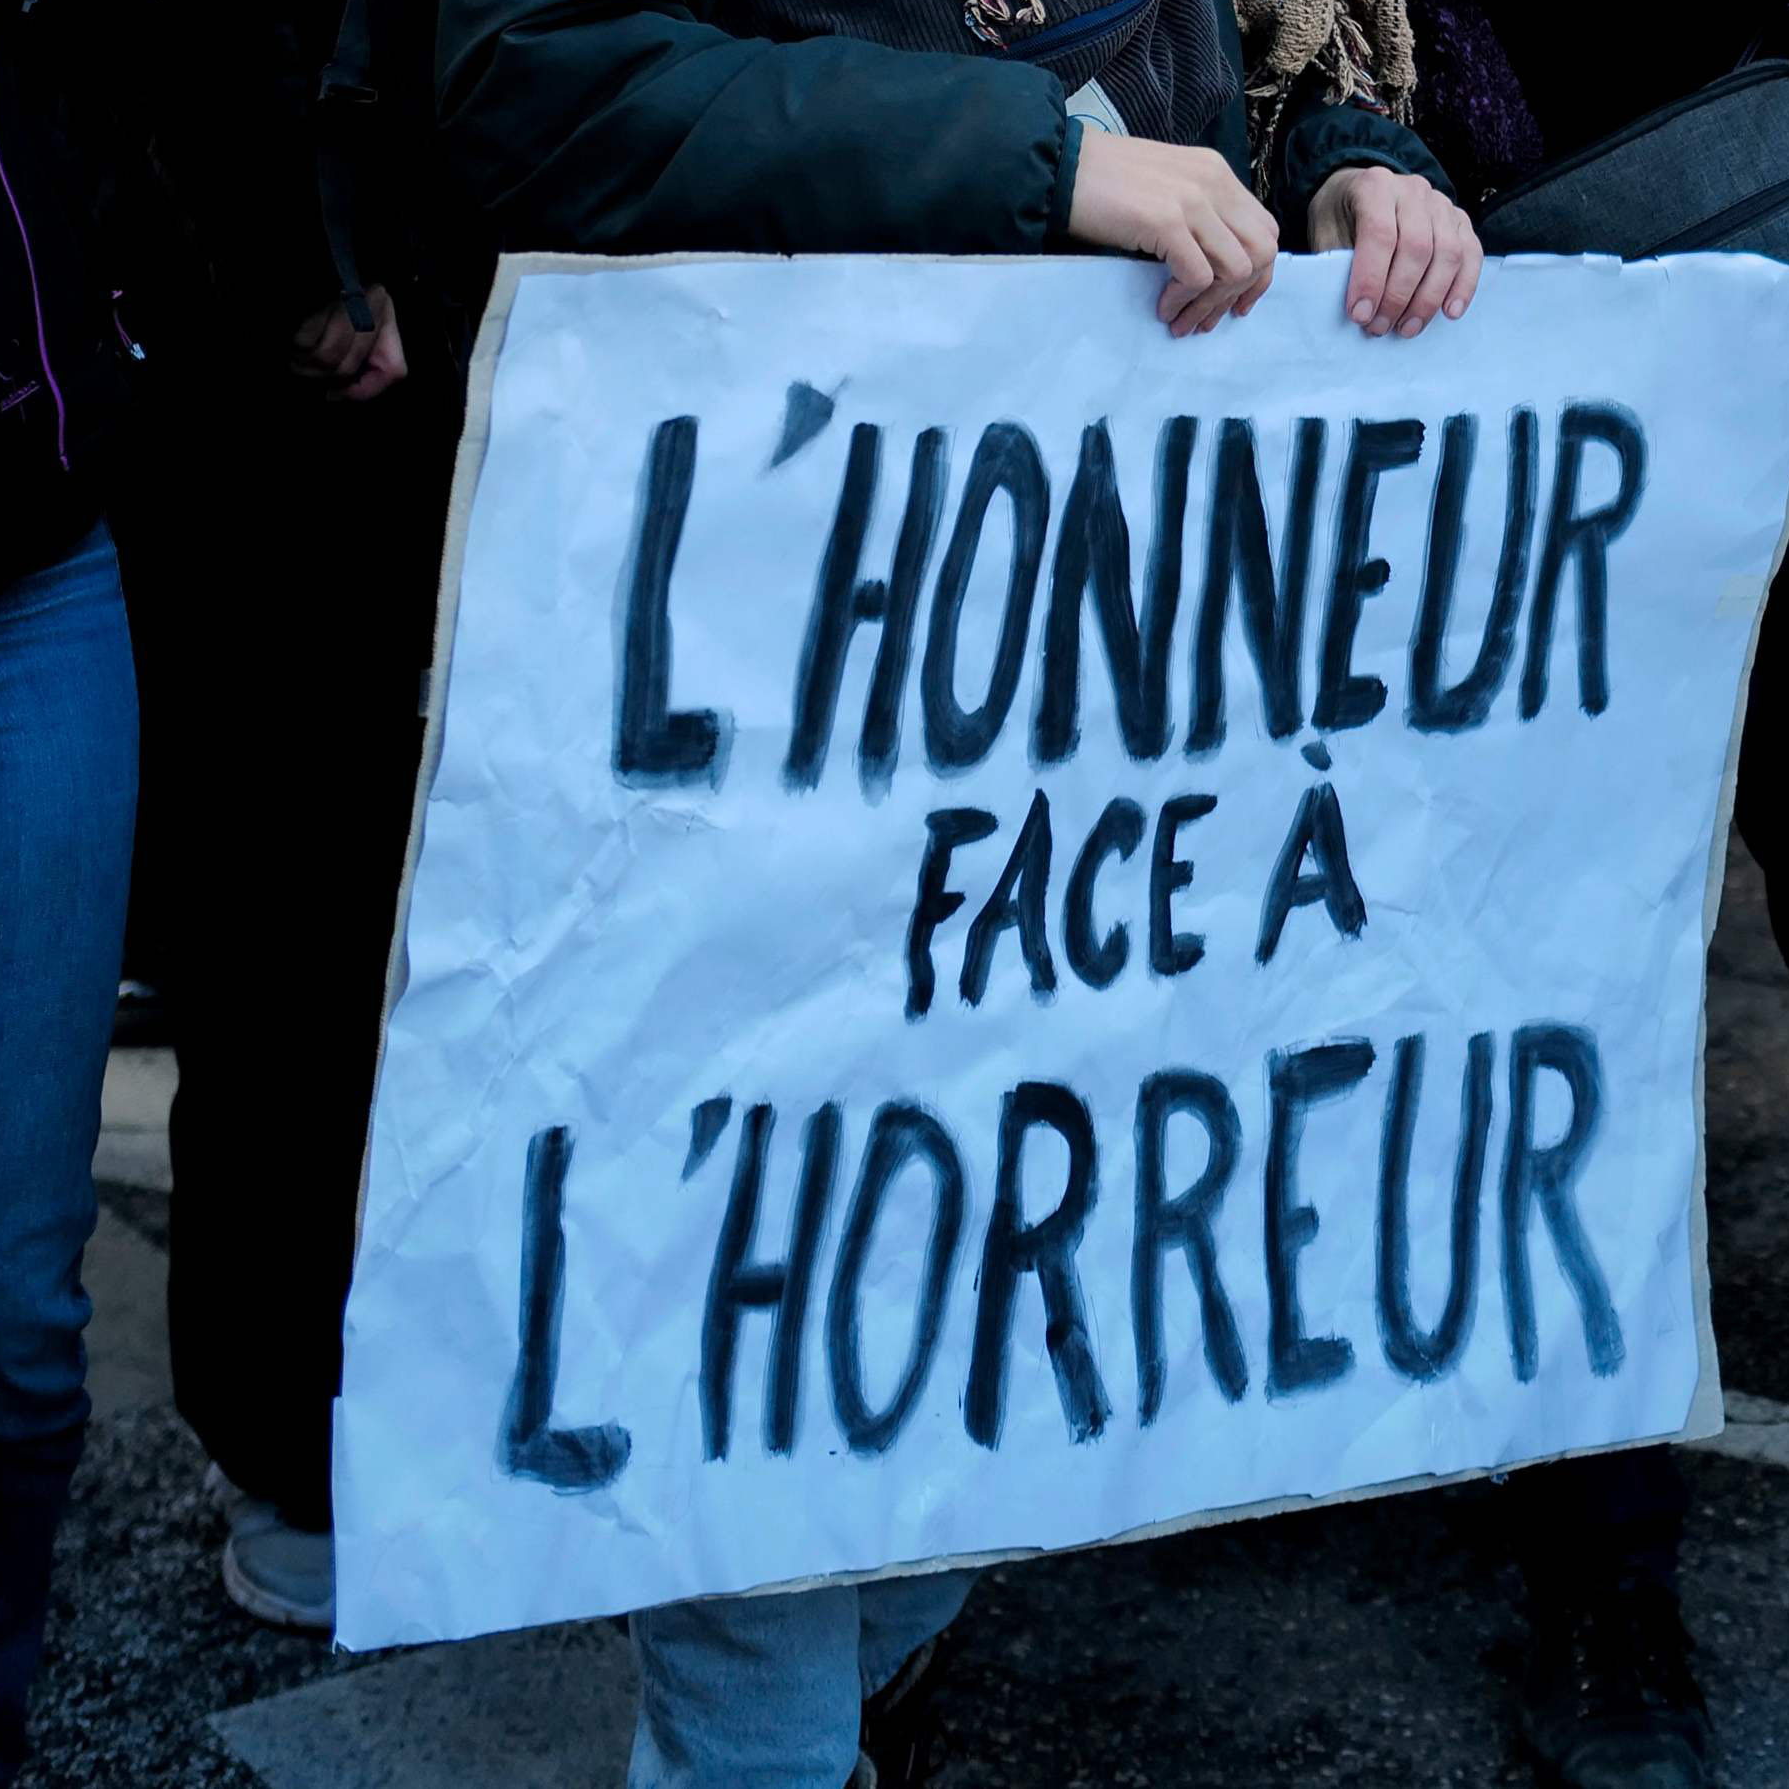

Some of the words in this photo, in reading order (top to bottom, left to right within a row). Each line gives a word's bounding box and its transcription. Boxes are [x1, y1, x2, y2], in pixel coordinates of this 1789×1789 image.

[611, 376, 1649, 796] L'HONNEUR
[904, 788, 1217, 1020] FACE
[1252, 741, 1368, 968] À
[496, 1023, 1624, 1492] L'HORREUR
